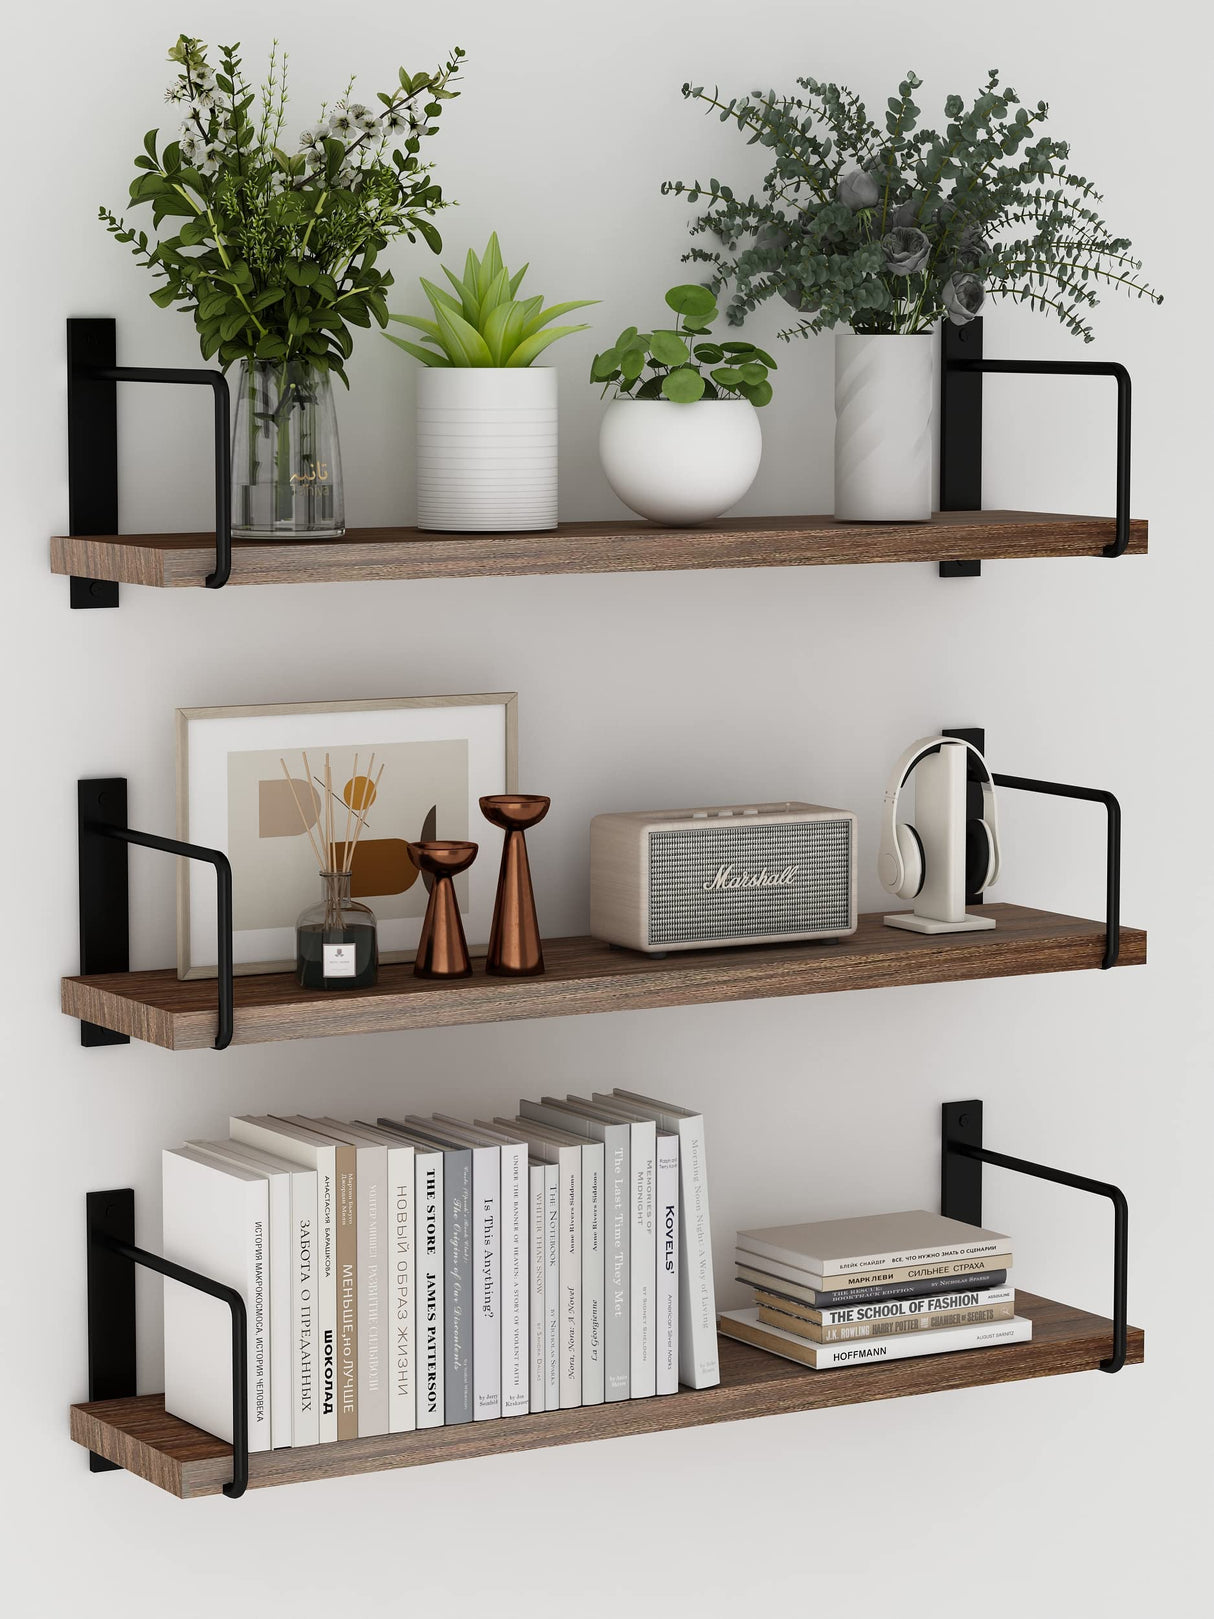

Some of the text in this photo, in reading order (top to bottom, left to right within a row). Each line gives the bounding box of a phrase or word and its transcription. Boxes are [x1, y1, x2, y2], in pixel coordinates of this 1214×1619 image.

[703, 864, 799, 890] Marshall
[691, 1139, 700, 1182] Morning
[694, 1185, 702, 1211] Noon
[513, 1234, 519, 1243] OF
[612, 1147, 624, 1318] The Last Time They Met
[647, 1220, 652, 1235] OF
[482, 1199, 494, 1318] Is This Anything?
[699, 1249, 705, 1257] A
[860, 1259, 886, 1267] СНАЙДЕР
[918, 1252, 940, 1260] НУЖНО
[966, 1245, 997, 1254] СЦЕНАРИИ
[450, 1198, 462, 1370] The Origins of Our Discontents
[848, 1262, 985, 1285] МАРК ЛЕВИ СИЛЬНЕЕ СТРАХА
[368, 1264, 378, 1322] РАЗВИТИЕ
[397, 1185, 409, 1396] НОВЫЙ ОБРАЗ ЖИЗНИ
[426, 1169, 436, 1413] THE STORE JAMES PATTERSON
[567, 1286, 575, 1314] Novel
[701, 1284, 708, 1293] of
[882, 1287, 915, 1295] EDITION
[299, 1220, 312, 1412] ЗАБОТА О ПРЕДАННЫХ
[514, 1316, 519, 1325] OF
[568, 1317, 575, 1325] A
[829, 1293, 979, 1324] THE SCHOOL OF FASHION
[930, 1314, 961, 1327] CHAMBER
[967, 1309, 994, 1322] SECRETS
[841, 1325, 870, 1339] ROWLING
[872, 1322, 894, 1335] HARRY
[895, 1319, 919, 1332] POTTER
[256, 1337, 264, 1376] ИСТОРИЯ
[591, 1350, 598, 1361] La
[833, 1347, 887, 1362] HOFFMANN
[323, 1330, 333, 1414] ШОКОЛАД
[343, 1360, 354, 1413] ЛУЧШЕ
[256, 1379, 264, 1422] ЧЕЛОВЕКА
